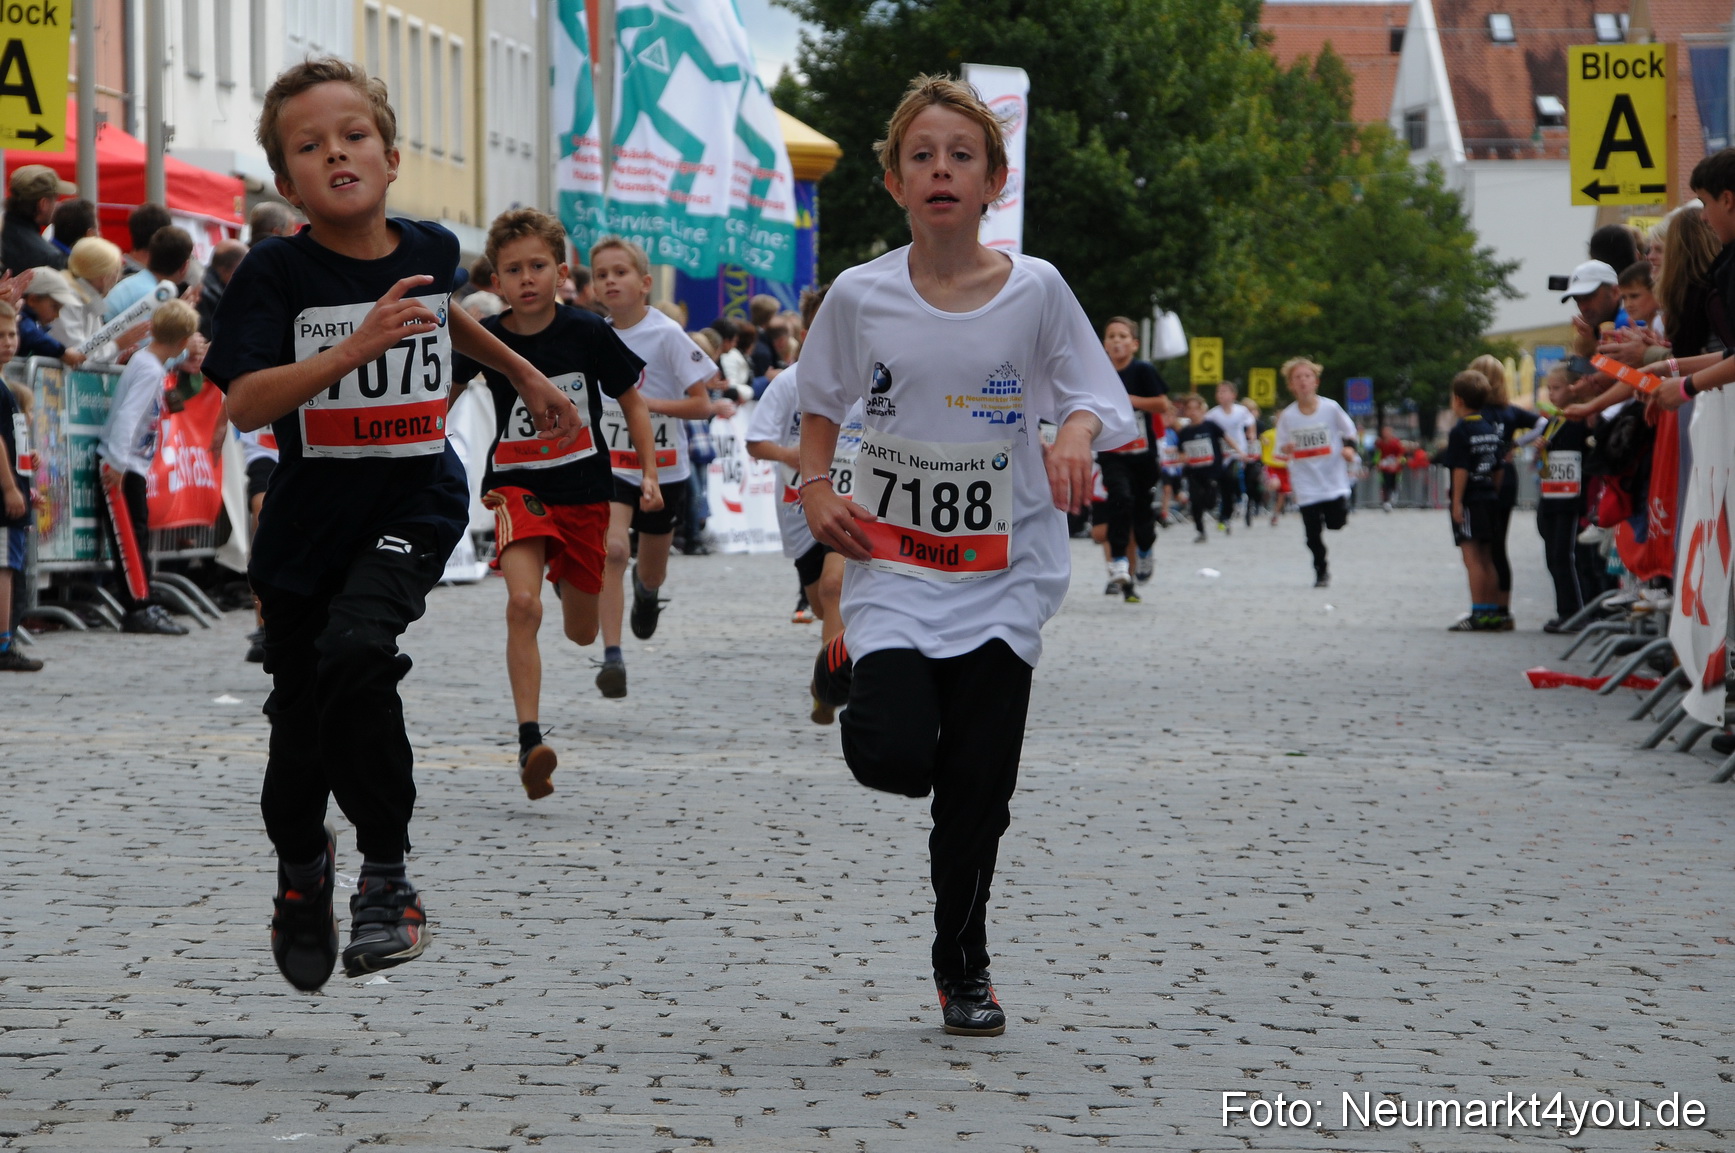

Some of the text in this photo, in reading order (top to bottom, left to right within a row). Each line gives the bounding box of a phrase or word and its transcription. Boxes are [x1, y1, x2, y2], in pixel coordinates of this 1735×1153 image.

[0, 0, 58, 26] lock
[0, 38, 42, 115] A
[1581, 51, 1665, 80] Block
[1592, 93, 1655, 170] A
[1199, 351, 1215, 372] C
[945, 395, 969, 408] 14.
[354, 415, 432, 440] Lorenz
[608, 423, 667, 448] 714
[861, 441, 985, 472] PARTL Neumarkt
[873, 467, 992, 533] 7188
[997, 522, 1006, 532] M
[899, 535, 959, 566] David
